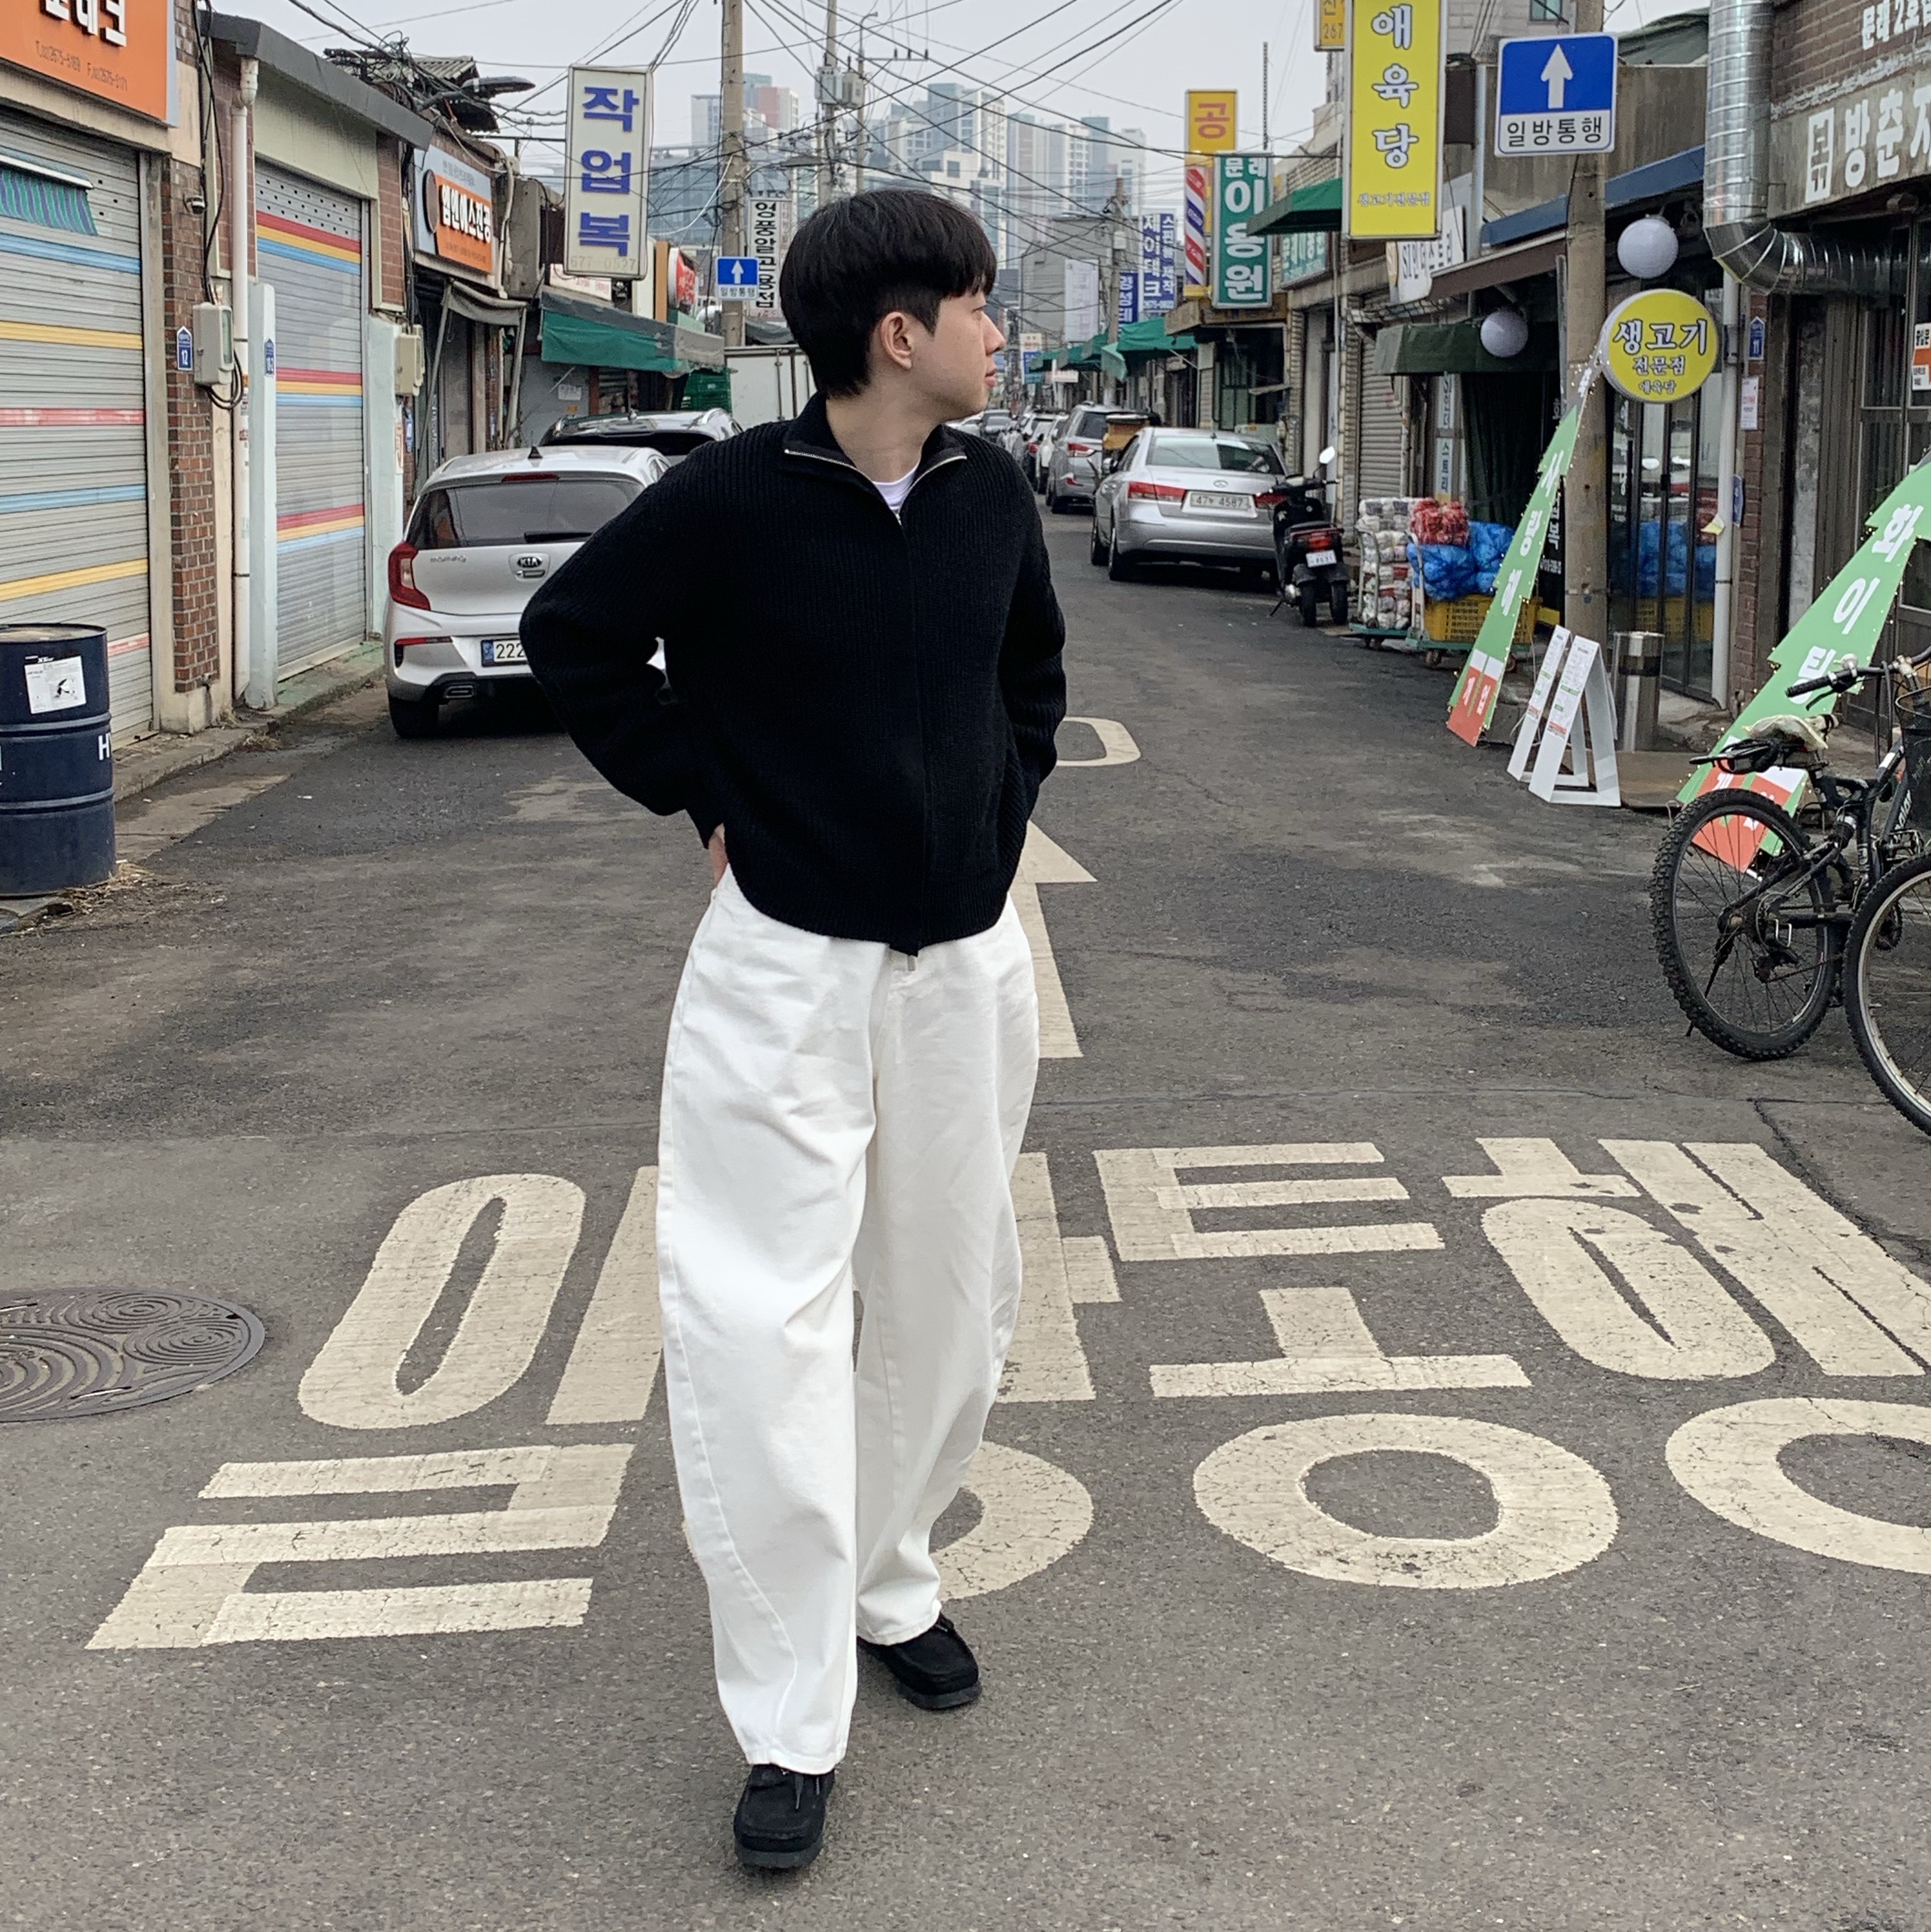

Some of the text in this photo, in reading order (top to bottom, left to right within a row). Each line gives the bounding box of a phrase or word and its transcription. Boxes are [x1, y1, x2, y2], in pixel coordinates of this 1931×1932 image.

[1371, 4, 1419, 169] 애육당
[1507, 117, 1602, 148] 일방통행
[577, 86, 639, 258] 작업복
[1358, 192, 1430, 208] 생고기전문점
[1224, 180, 1265, 300] 이용원
[1613, 318, 1708, 356] 생고기
[181, 349, 188, 366] 12
[1633, 355, 1686, 376] 전문점
[519, 557, 541, 568] KIA
[1789, 503, 1925, 704] 화이팅
